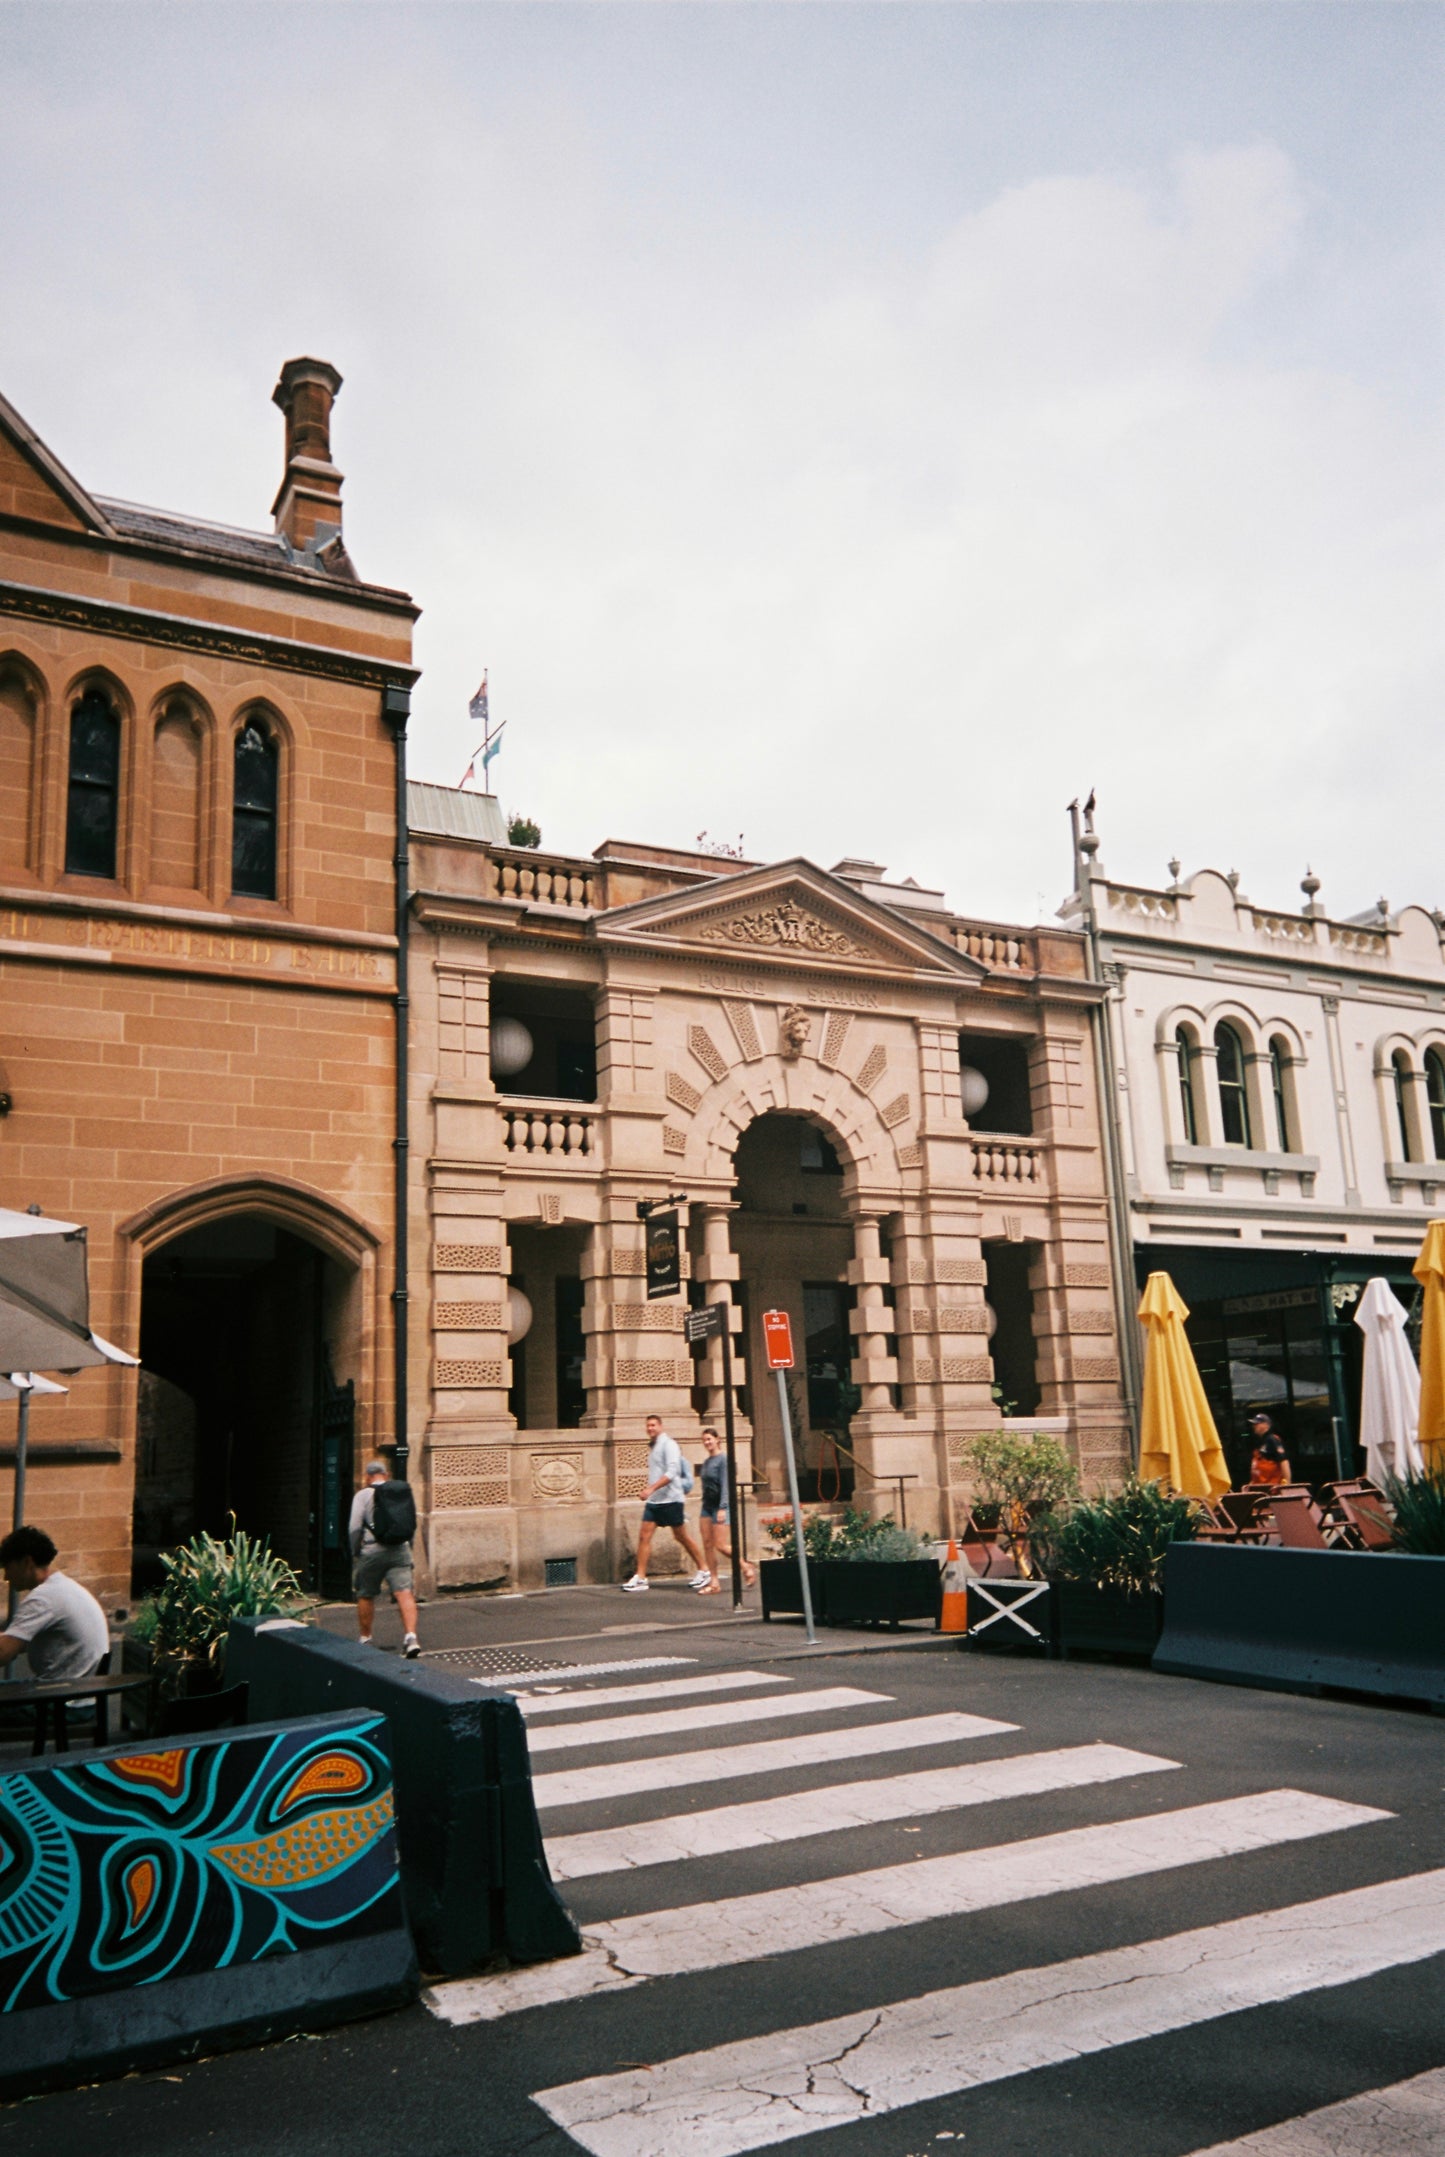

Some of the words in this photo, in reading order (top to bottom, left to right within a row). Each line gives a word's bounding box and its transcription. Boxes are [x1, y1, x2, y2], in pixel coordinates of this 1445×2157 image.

[65, 917, 272, 964] CHARTERED
[698, 973, 766, 996] POLICE
[807, 986, 879, 1009] STATION
